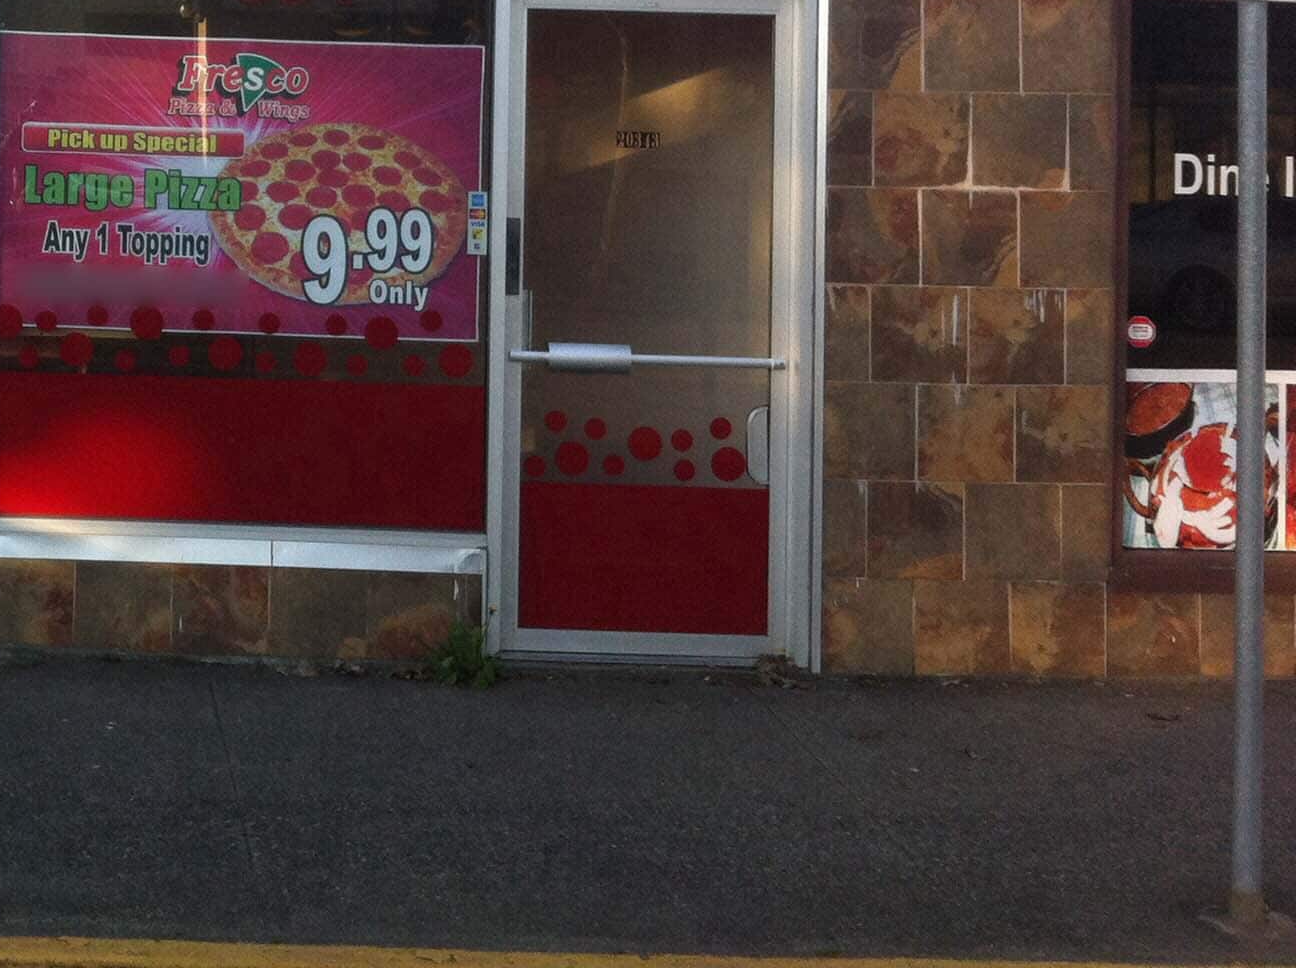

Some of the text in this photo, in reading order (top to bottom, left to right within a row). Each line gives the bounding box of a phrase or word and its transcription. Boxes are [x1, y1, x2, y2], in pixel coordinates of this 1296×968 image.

[177, 54, 310, 95] Fresco
[168, 97, 311, 122] Pizza & Wings
[47, 128, 217, 154] Pick up Special
[23, 163, 243, 212] Large Pizza
[1173, 152, 1270, 196] Din
[42, 220, 212, 267] Any 1 Topping
[301, 205, 434, 307] 9.99
[368, 278, 429, 312] Only
